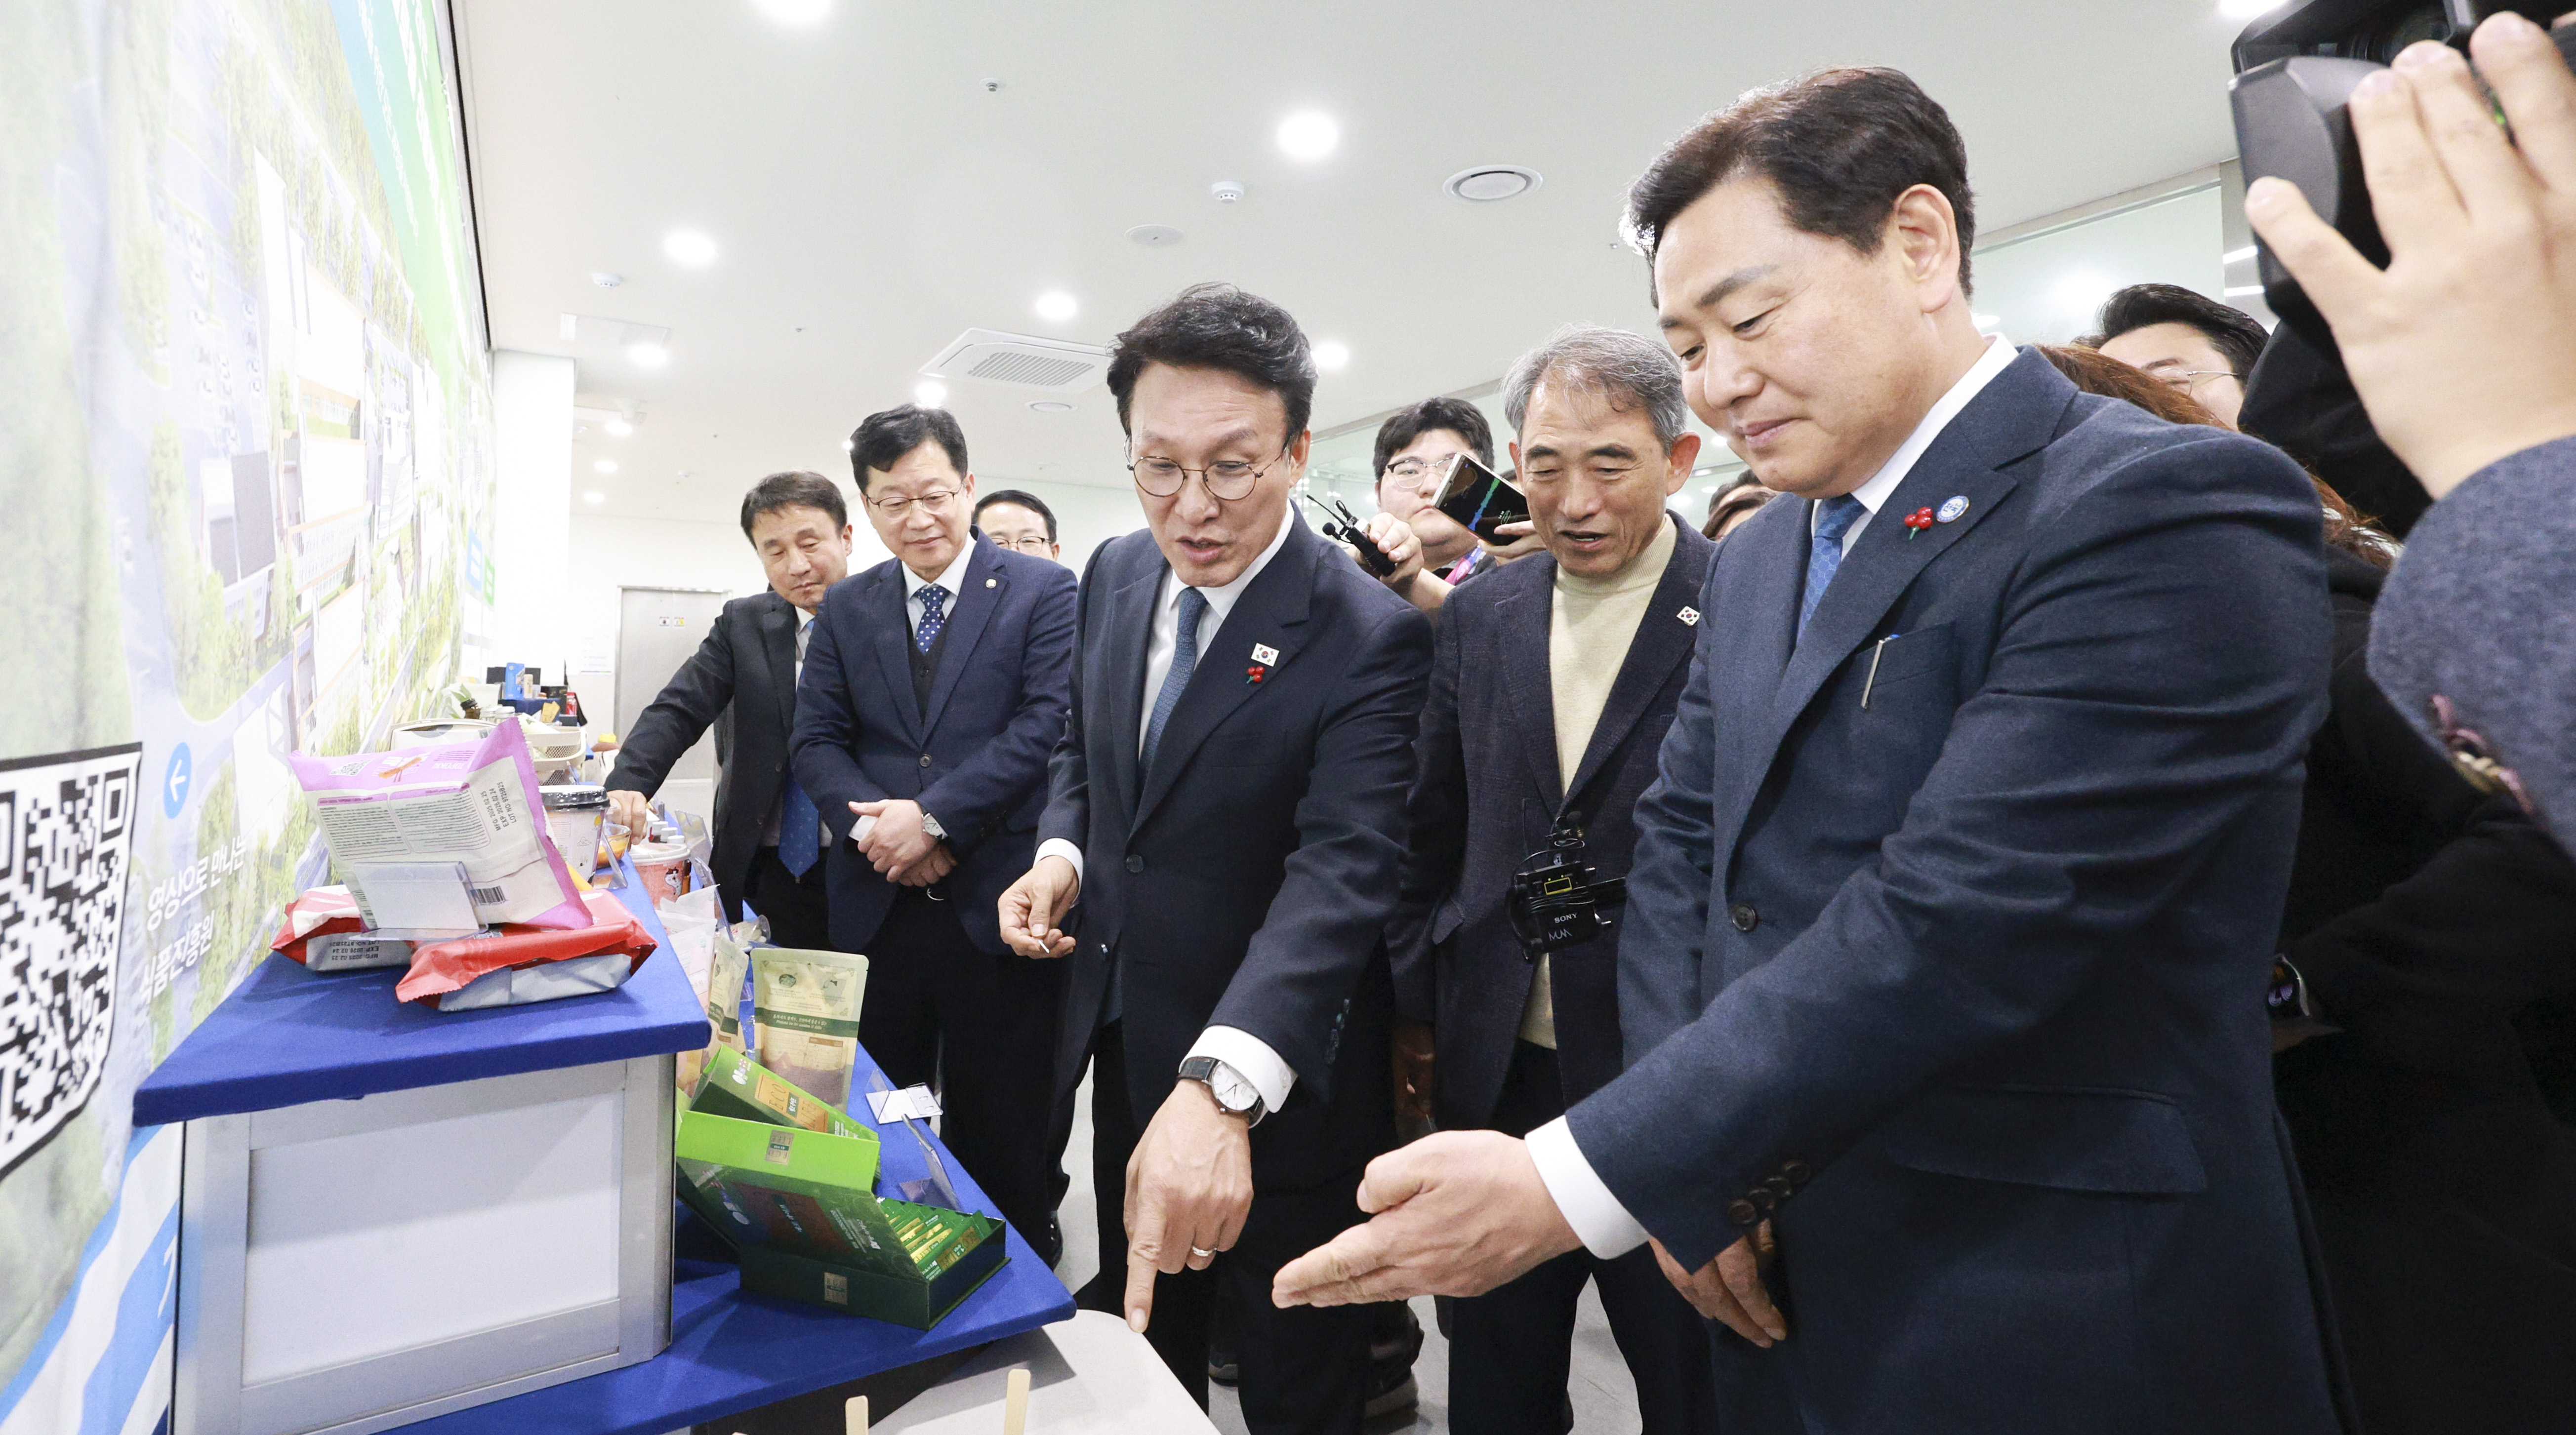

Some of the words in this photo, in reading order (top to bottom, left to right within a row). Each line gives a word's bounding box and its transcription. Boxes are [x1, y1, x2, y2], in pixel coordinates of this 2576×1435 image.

[508, 813, 517, 823] LOT
[147, 855, 208, 931] 영상으로
[211, 836, 246, 888] 만나는
[1554, 912, 1577, 923] SONY
[139, 910, 215, 1004] 식품진흥원
[769, 1083, 786, 1111] ECO
